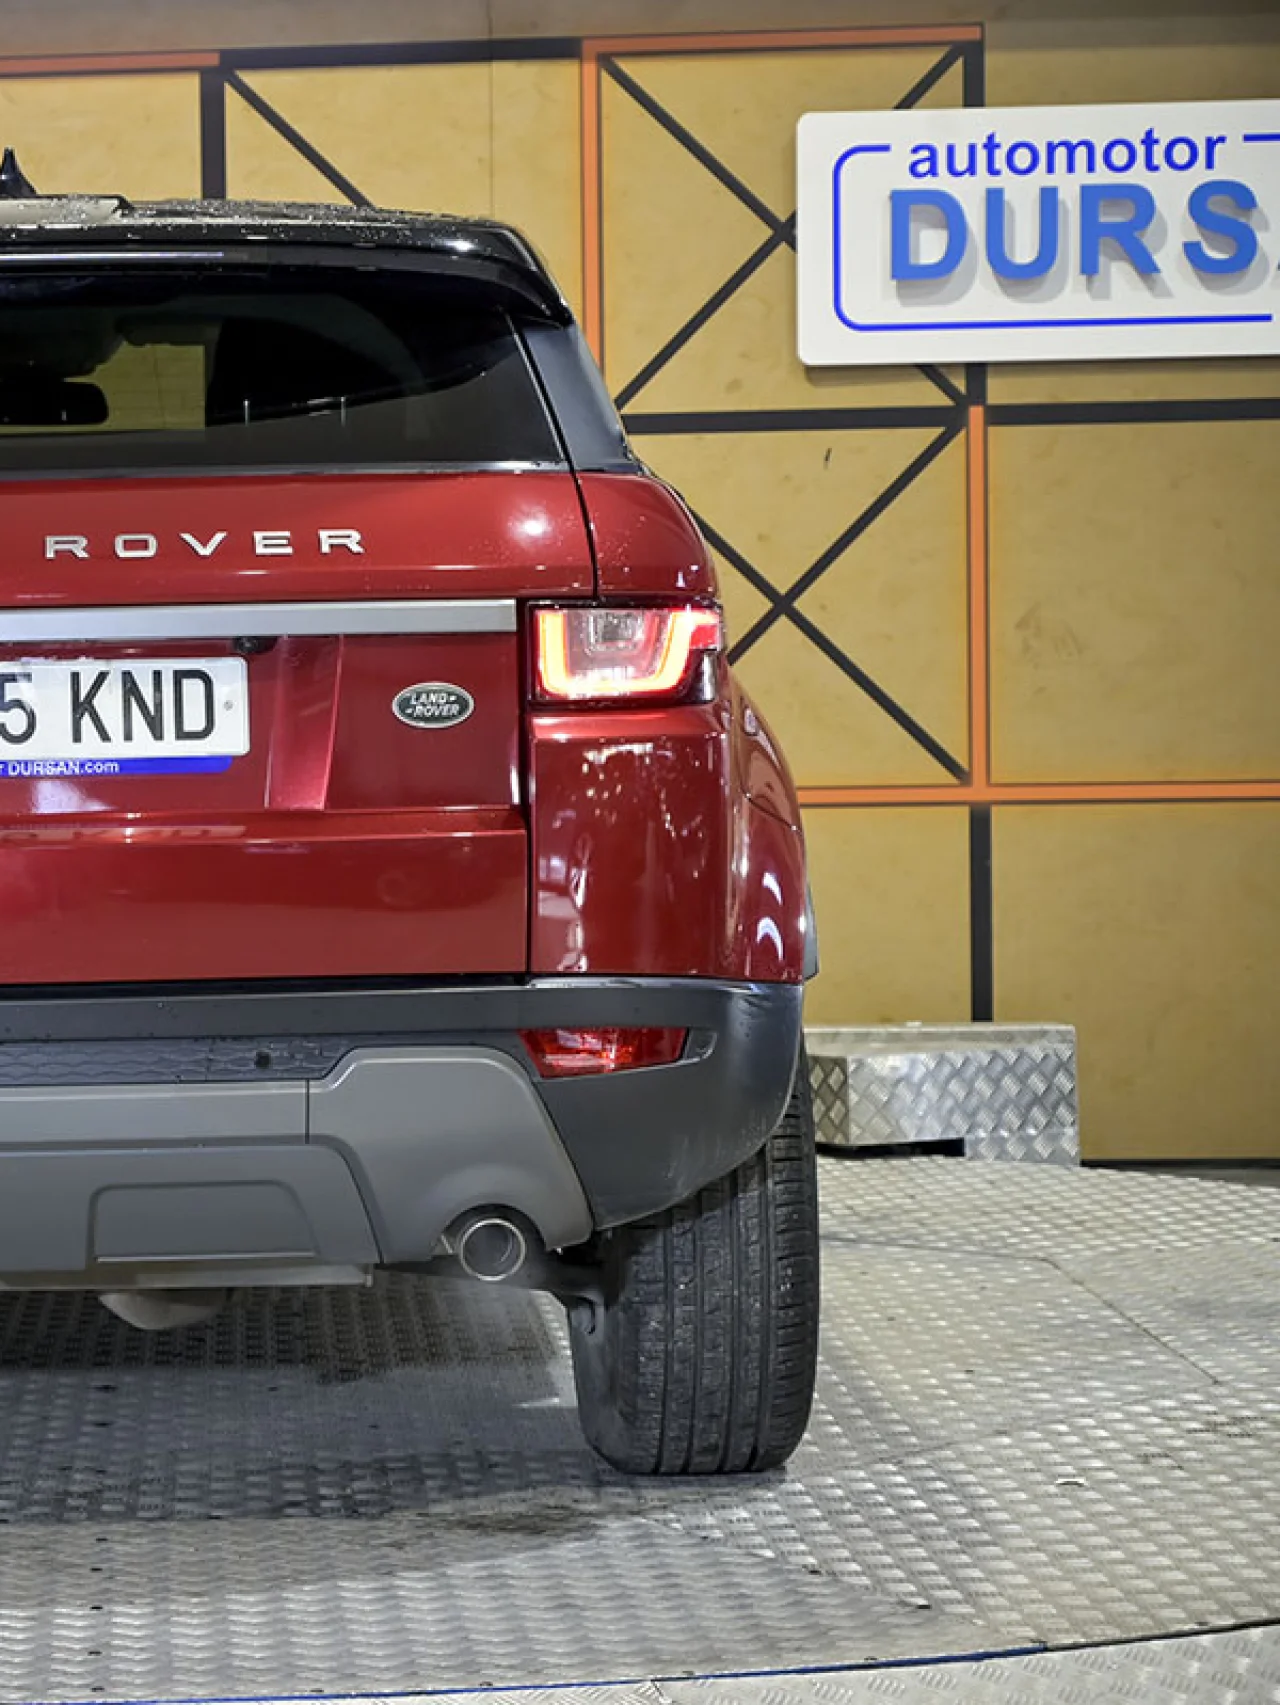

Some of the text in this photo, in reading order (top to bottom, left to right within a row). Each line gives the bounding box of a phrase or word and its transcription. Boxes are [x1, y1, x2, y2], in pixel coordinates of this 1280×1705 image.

[908, 128, 1227, 178] automotor
[889, 179, 1280, 281] DURS
[44, 528, 366, 560] ROVER
[71, 669, 216, 744] KND
[7, 760, 120, 777] DURSAN.com
